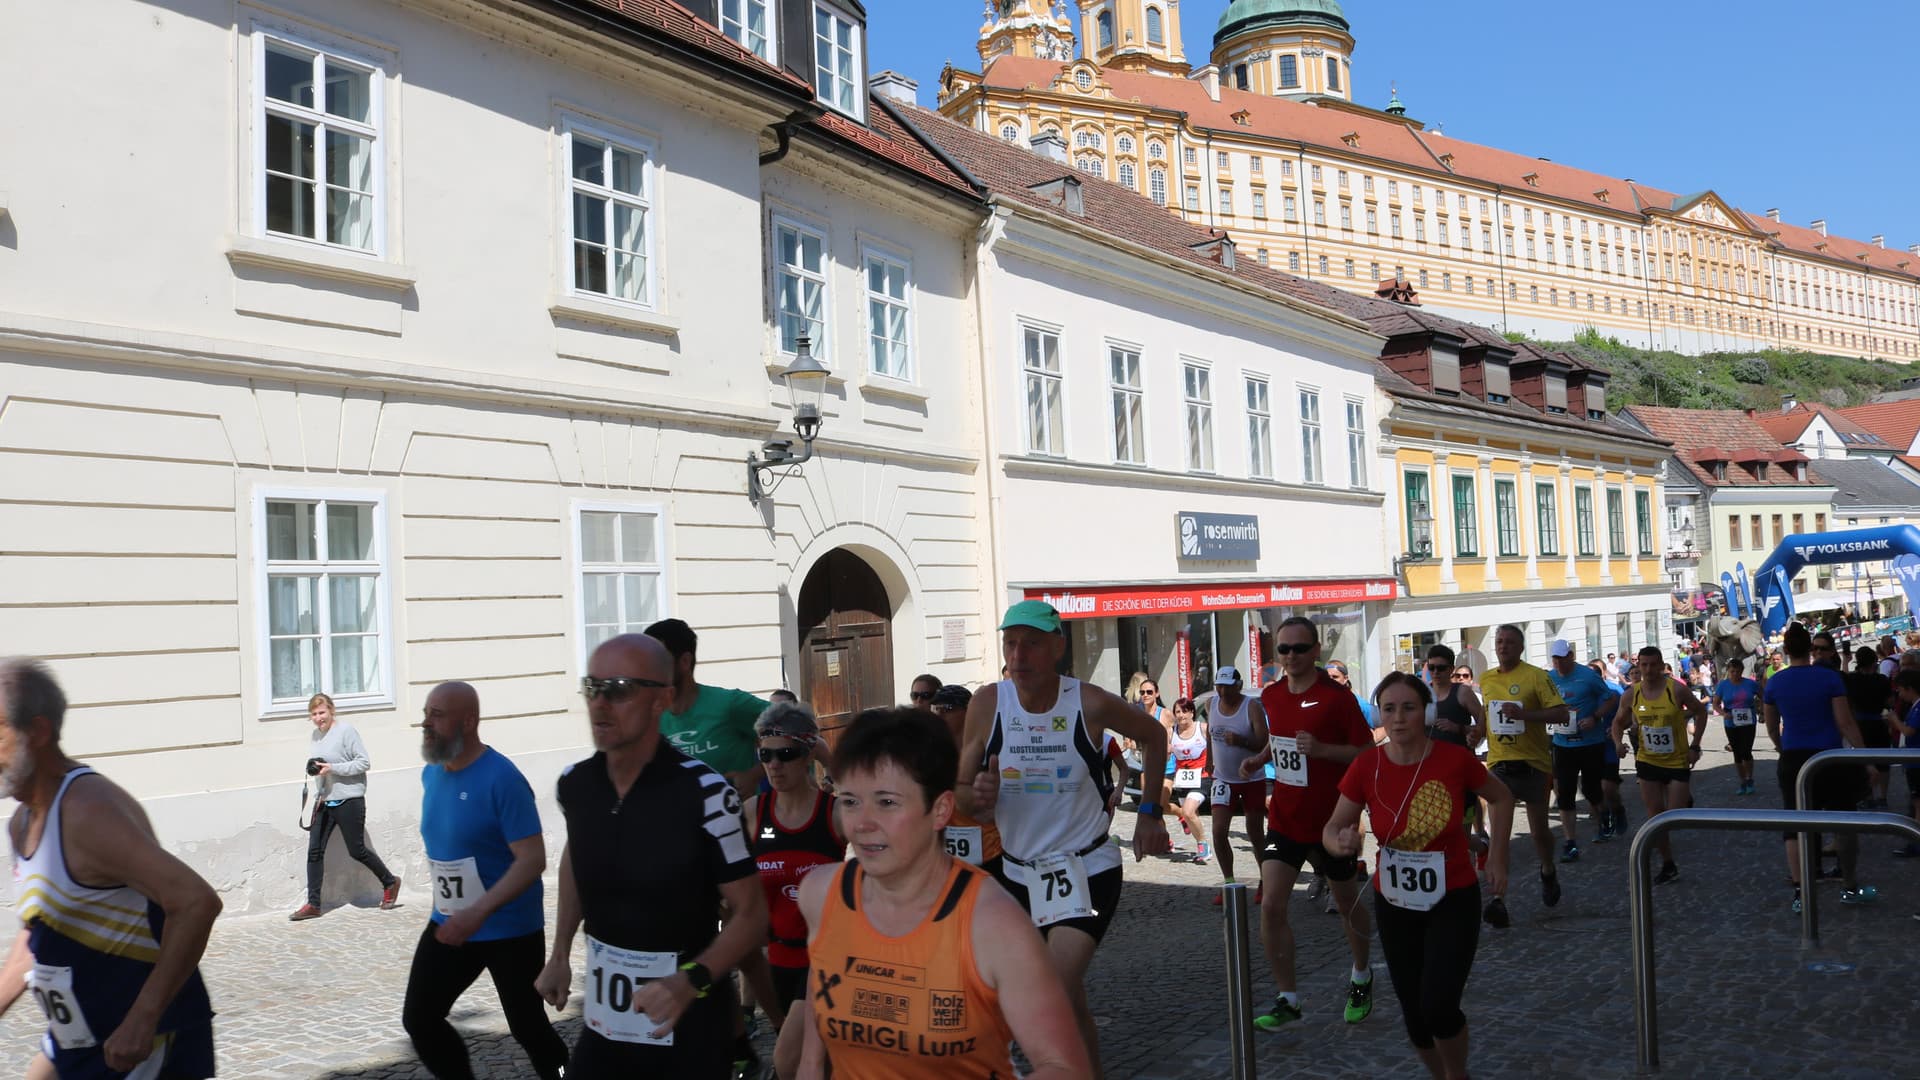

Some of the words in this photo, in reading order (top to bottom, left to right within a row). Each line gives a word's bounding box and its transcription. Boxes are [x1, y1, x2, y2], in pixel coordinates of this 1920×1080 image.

[1204, 522, 1258, 540] rosenwirth
[1816, 539, 1889, 554] VOLKSBANK
[1102, 600, 1111, 612] DIE
[1114, 597, 1140, 611] SCHÖNE
[1141, 599, 1156, 610] WELT
[1157, 598, 1169, 609] DER
[1169, 595, 1193, 608] KÜCHEN
[1737, 711, 1748, 722] 56
[1645, 733, 1670, 746] 133
[1272, 749, 1302, 772] 138
[1181, 770, 1195, 782] 33
[1212, 784, 1226, 797] 13
[945, 838, 970, 857] 59
[1040, 868, 1073, 902] 75
[1386, 864, 1438, 893] 130
[437, 875, 464, 900] 37
[932, 993, 964, 1007] holz
[827, 1018, 909, 1052] STRIGL
